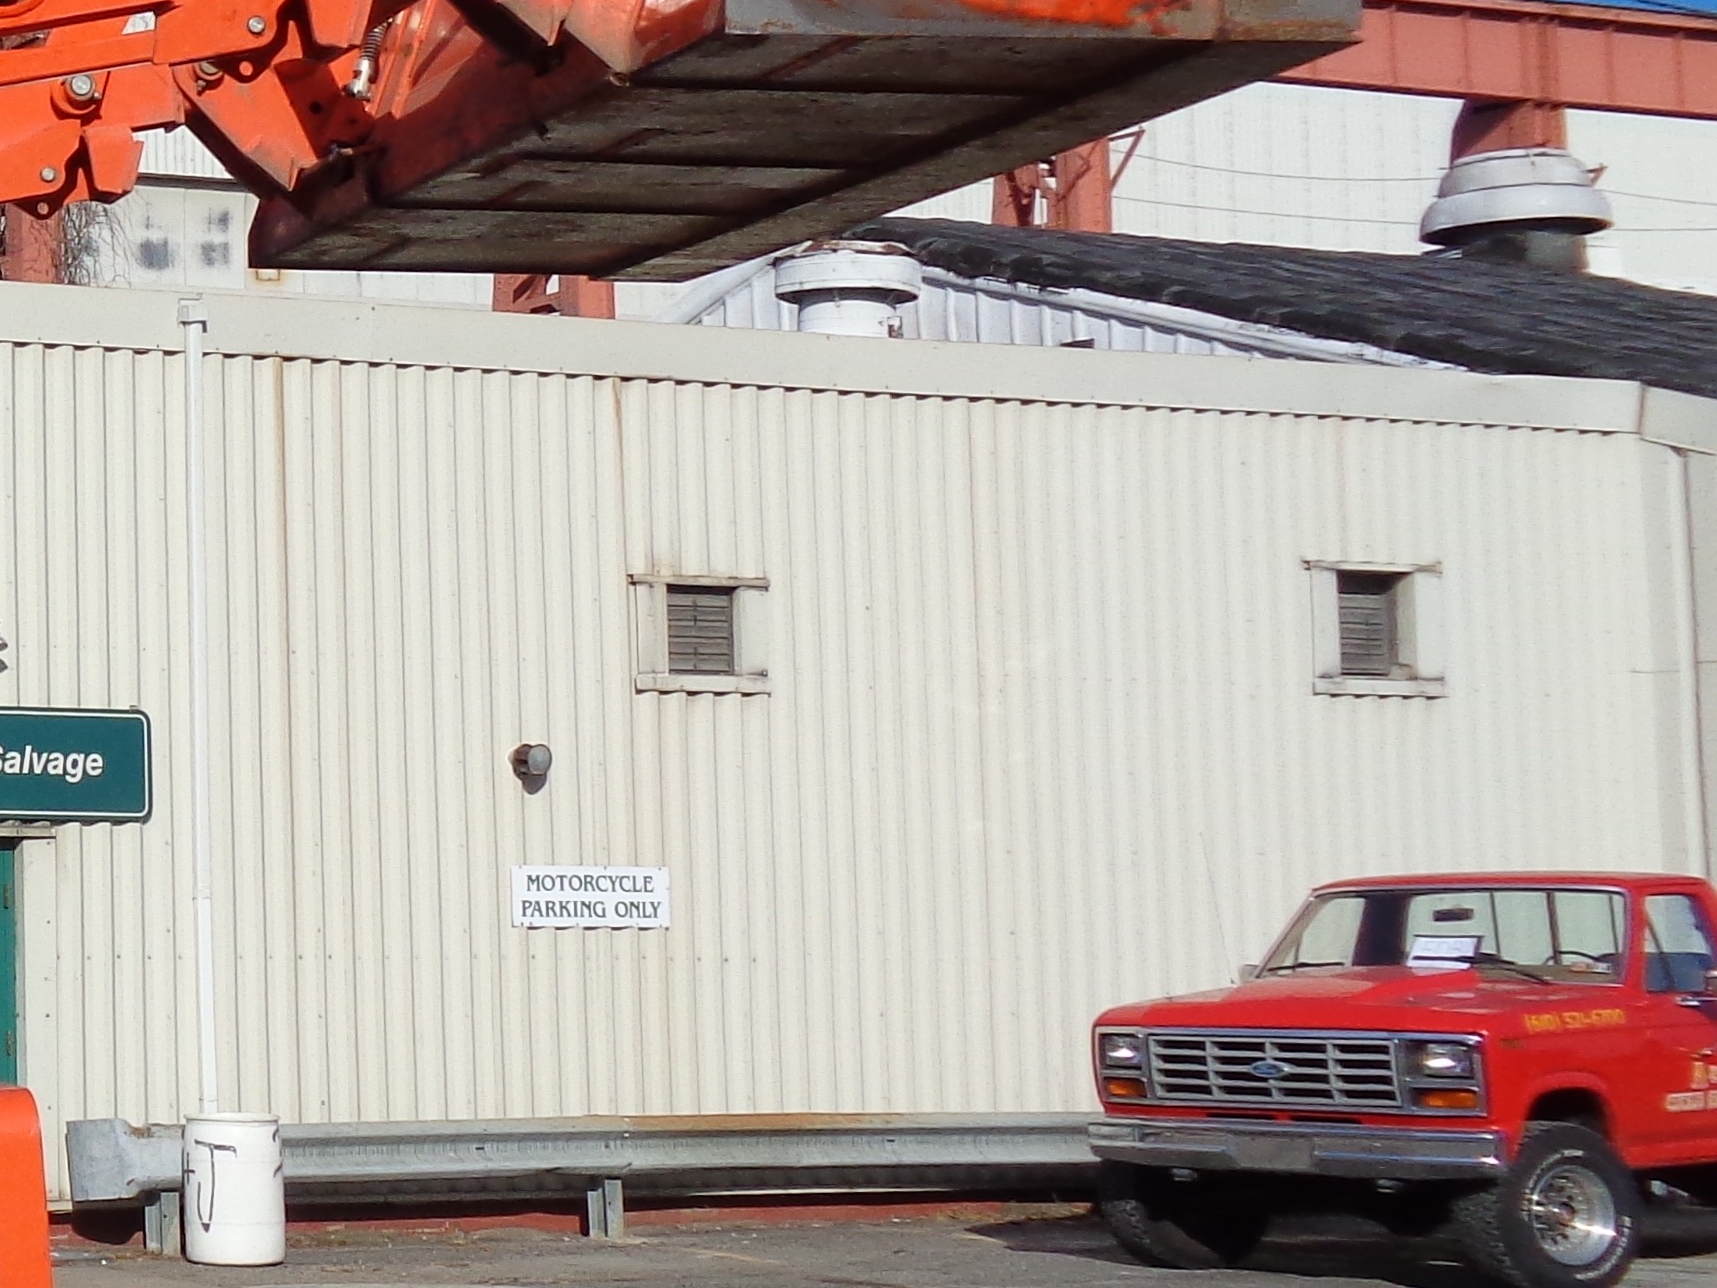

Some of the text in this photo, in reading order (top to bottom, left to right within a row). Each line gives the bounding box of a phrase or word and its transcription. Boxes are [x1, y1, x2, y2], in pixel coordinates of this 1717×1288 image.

[526, 874, 654, 893] MOTORCYCLE
[521, 900, 662, 919] PARKING ONLY
